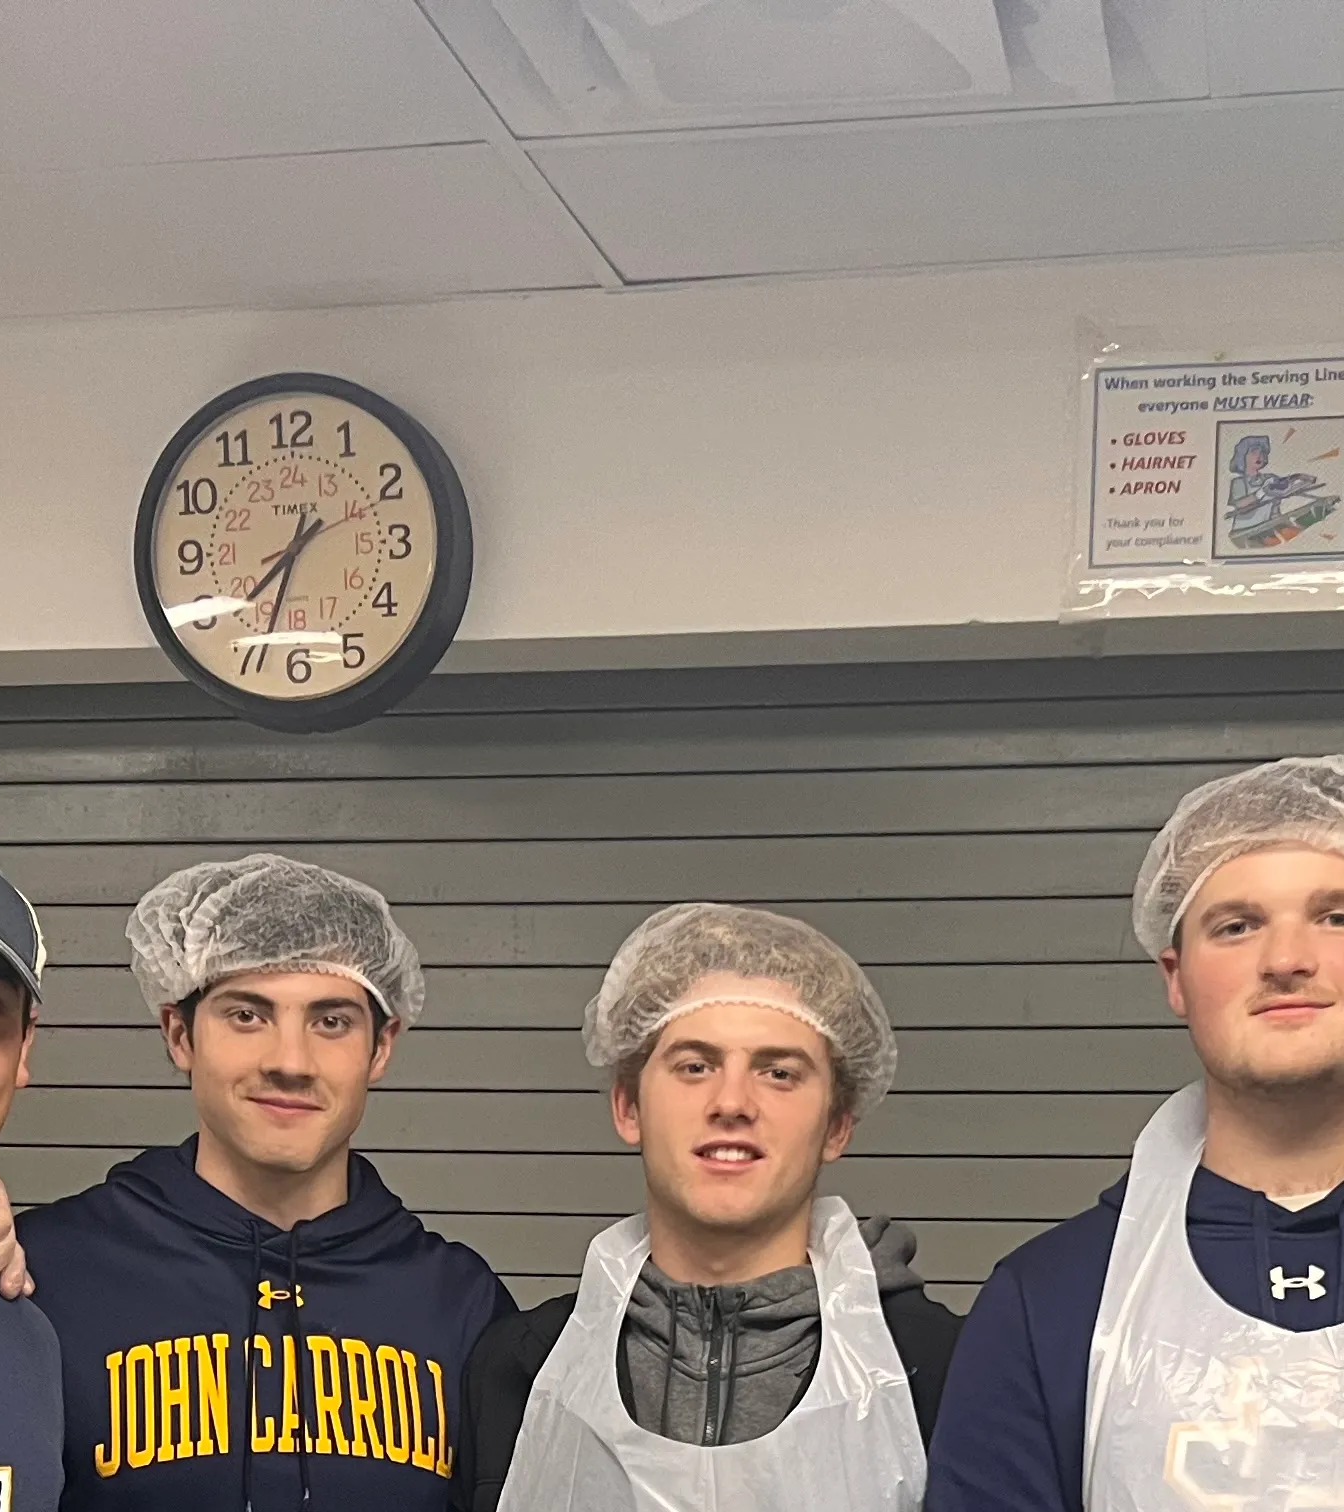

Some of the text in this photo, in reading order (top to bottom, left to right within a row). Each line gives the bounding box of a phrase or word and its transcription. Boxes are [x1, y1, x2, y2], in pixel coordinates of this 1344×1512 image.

[1104, 376, 1149, 391] When
[1153, 373, 1216, 391] working
[1221, 371, 1246, 387] the
[1251, 368, 1309, 388] Serving
[1137, 392, 1315, 415] everyone MUST WEAR:
[268, 410, 314, 450] 12
[336, 420, 356, 458] 1
[1122, 430, 1186, 447] GLOVES
[215, 428, 253, 468] 11
[1121, 454, 1197, 472] HAIRNET
[279, 465, 308, 489] 24
[318, 474, 338, 498] 13
[379, 463, 404, 501] 2
[1119, 480, 1182, 496] APRON
[176, 478, 218, 516] 10
[247, 479, 275, 503] 23
[225, 509, 252, 533] 22
[271, 501, 319, 517] TIMEX
[355, 531, 374, 555] 15
[388, 523, 412, 560] 3
[177, 540, 204, 576] 9
[218, 543, 236, 566] 21
[344, 568, 365, 591] 16
[319, 596, 339, 621] 17
[371, 581, 398, 617] 4
[288, 609, 307, 630] 18
[341, 632, 366, 669] 5
[286, 648, 312, 684] 6
[94, 1333, 230, 1479] JOHN
